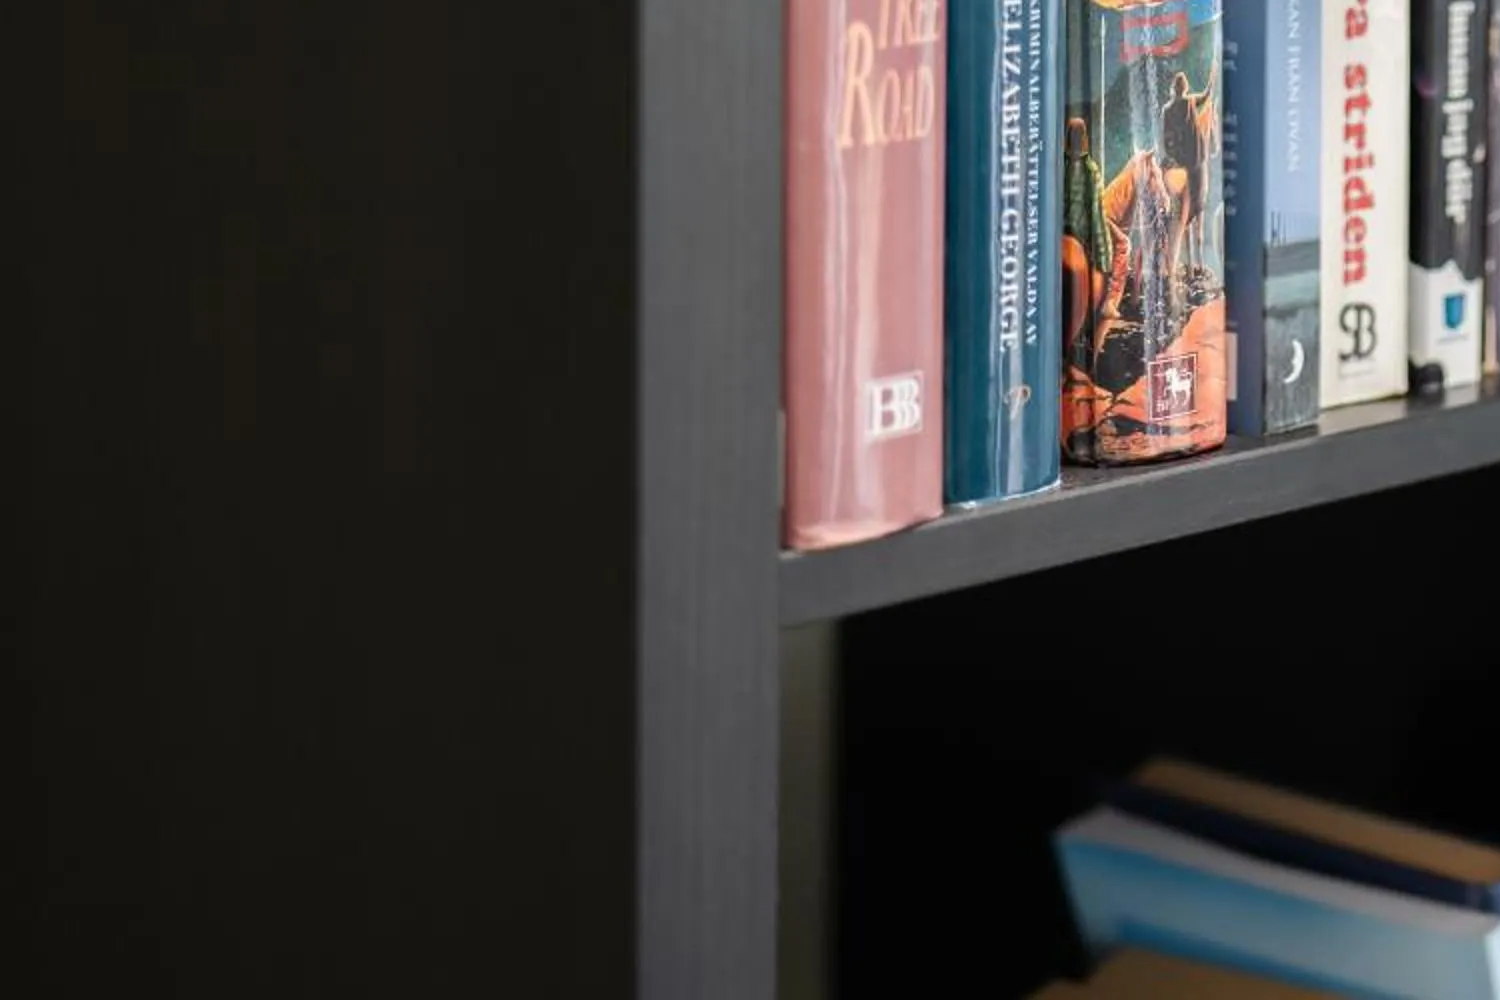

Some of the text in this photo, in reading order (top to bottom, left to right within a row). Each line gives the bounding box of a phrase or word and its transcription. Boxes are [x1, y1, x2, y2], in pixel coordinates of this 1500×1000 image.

[839, 21, 936, 147] ROAD
[1341, 63, 1376, 286] striden
[1000, 206, 1021, 353] GEORGE
